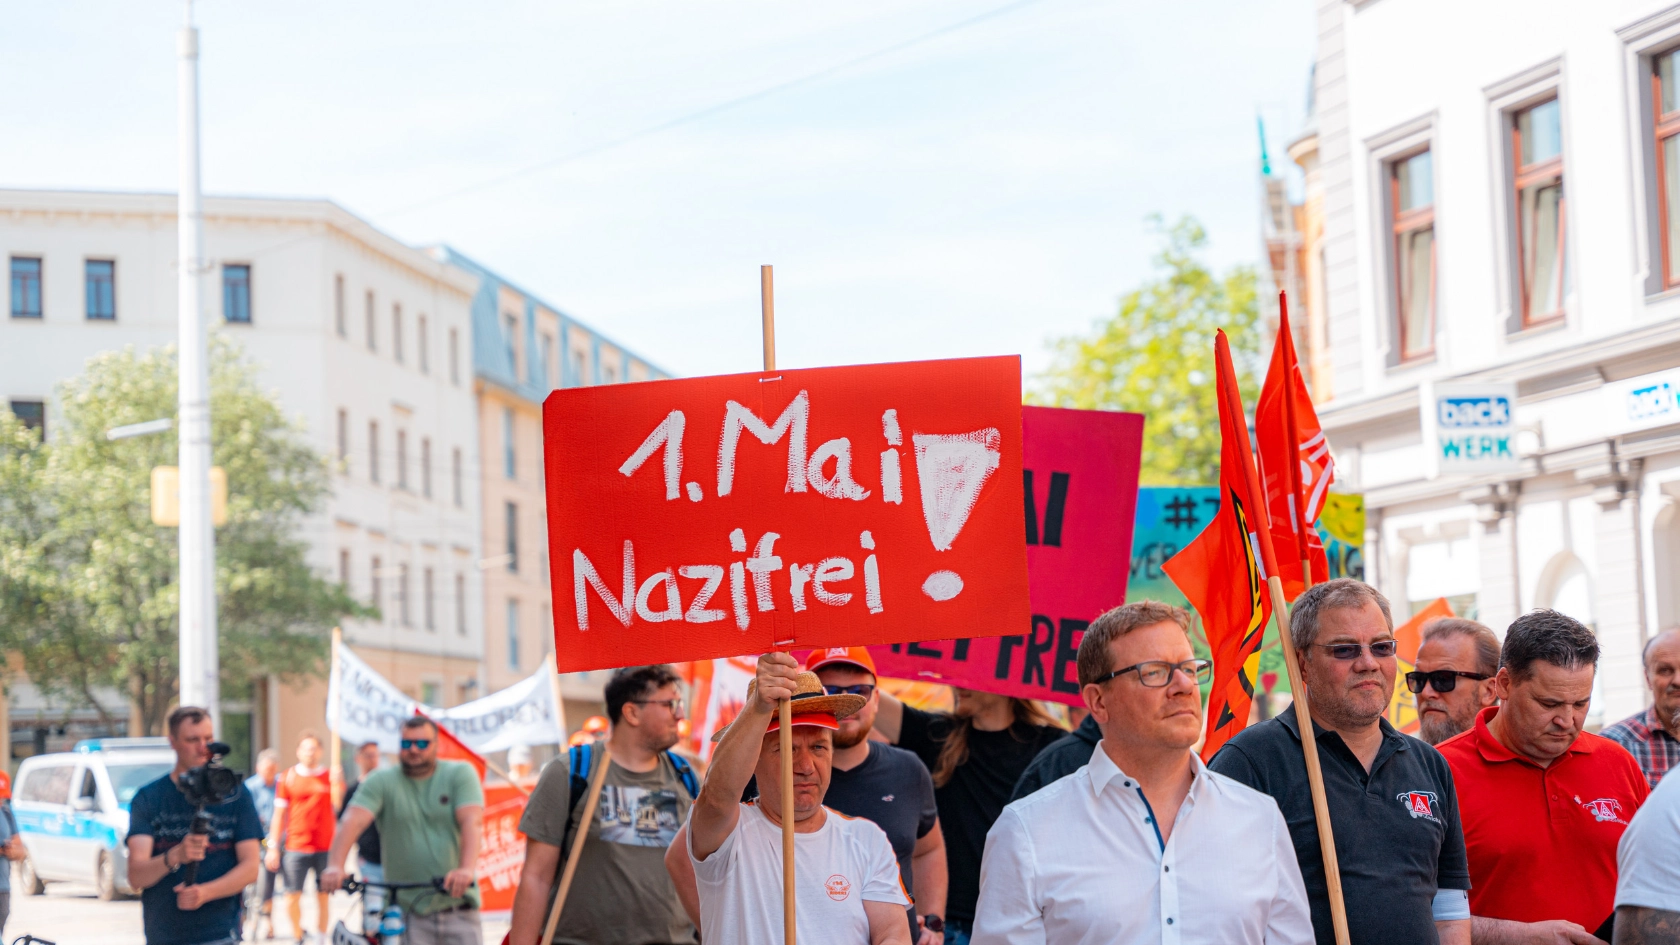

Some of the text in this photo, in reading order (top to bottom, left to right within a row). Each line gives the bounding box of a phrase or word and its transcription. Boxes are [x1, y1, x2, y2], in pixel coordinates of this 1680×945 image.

[1438, 397, 1509, 427] back
[618, 409, 703, 503] 1.
[1440, 434, 1512, 459] WERK
